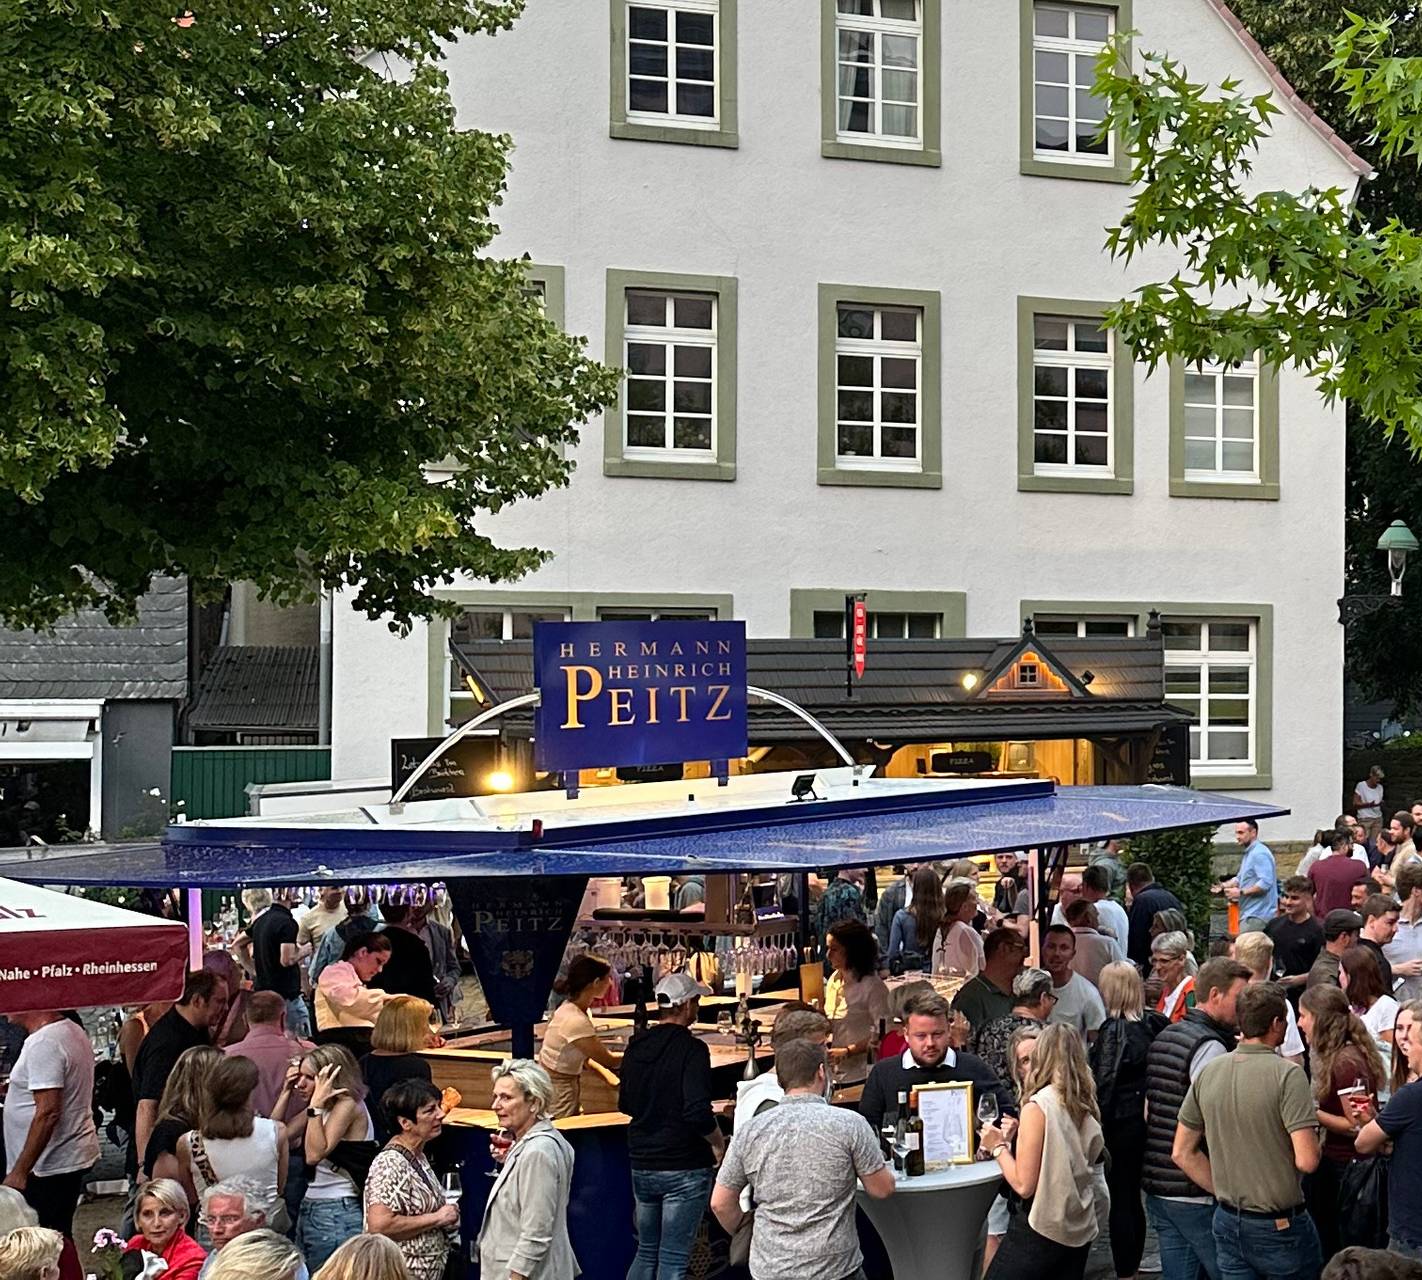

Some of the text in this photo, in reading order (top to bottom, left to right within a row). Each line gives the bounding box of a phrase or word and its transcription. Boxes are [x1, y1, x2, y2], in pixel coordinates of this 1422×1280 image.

[560, 640, 731, 658] HERMANN
[608, 662, 732, 679] HEINRICH
[560, 665, 732, 729] PEITZ
[472, 910, 564, 934] PEITZ
[0, 960, 158, 981] Nahe Pfalz Rheinhessen
